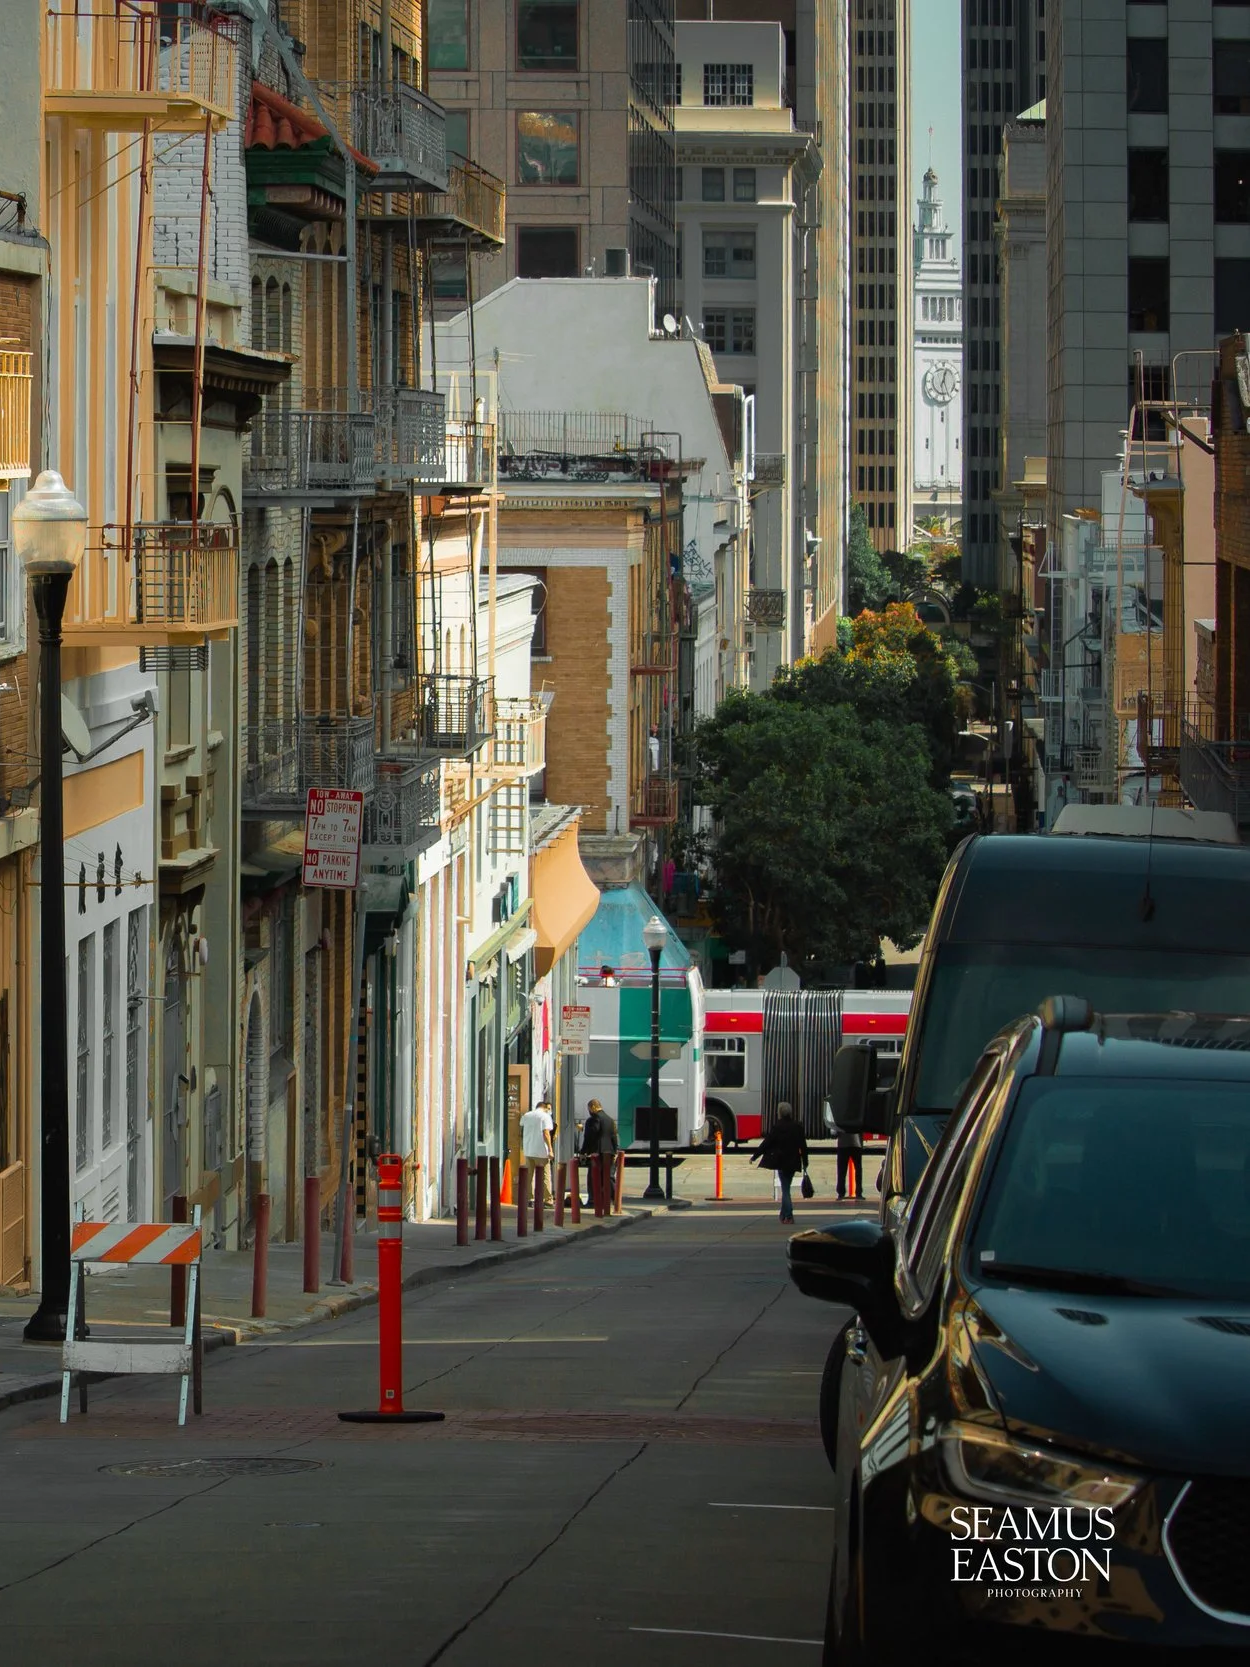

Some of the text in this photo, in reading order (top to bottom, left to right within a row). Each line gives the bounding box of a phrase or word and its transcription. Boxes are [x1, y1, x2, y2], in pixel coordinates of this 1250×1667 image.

[310, 799, 358, 815] NO STOPPING
[330, 823, 338, 832] TO
[310, 833, 356, 843] EXCEPT SUN
[306, 853, 351, 867] NO PARKING
[312, 869, 348, 881] ANYTIME
